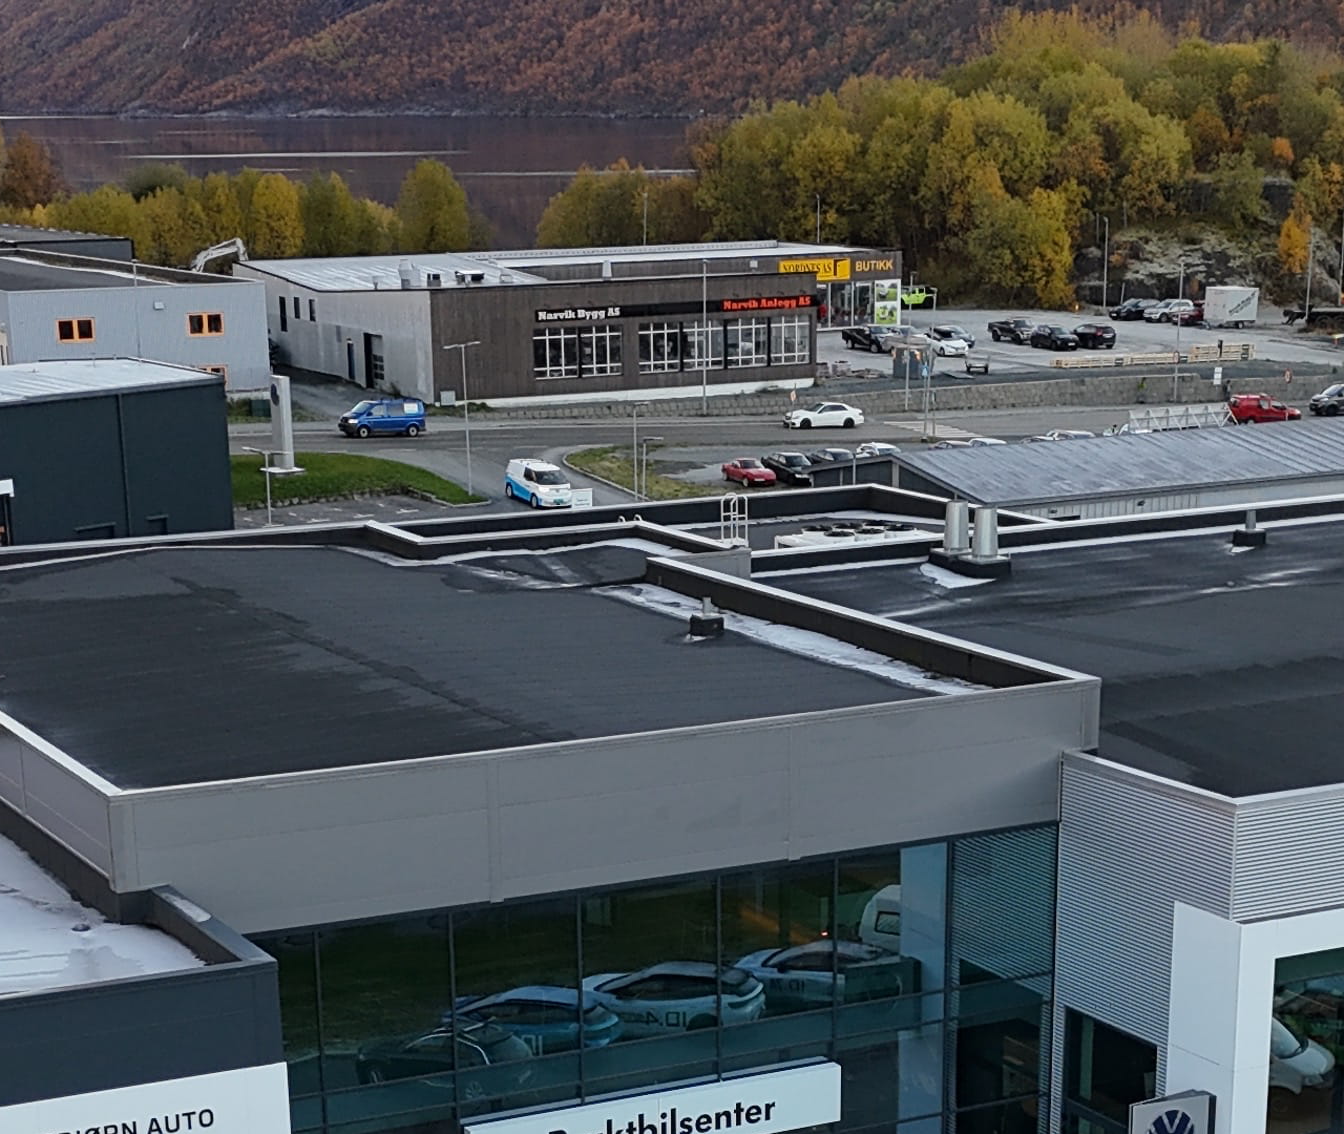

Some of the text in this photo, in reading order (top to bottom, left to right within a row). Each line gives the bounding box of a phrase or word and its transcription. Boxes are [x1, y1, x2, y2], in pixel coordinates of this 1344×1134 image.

[822, 262, 833, 272] AS
[855, 259, 894, 271] BUTIKK
[722, 295, 811, 310] Narvik Anlegg AS
[537, 306, 621, 320] Narvik Bygg AS
